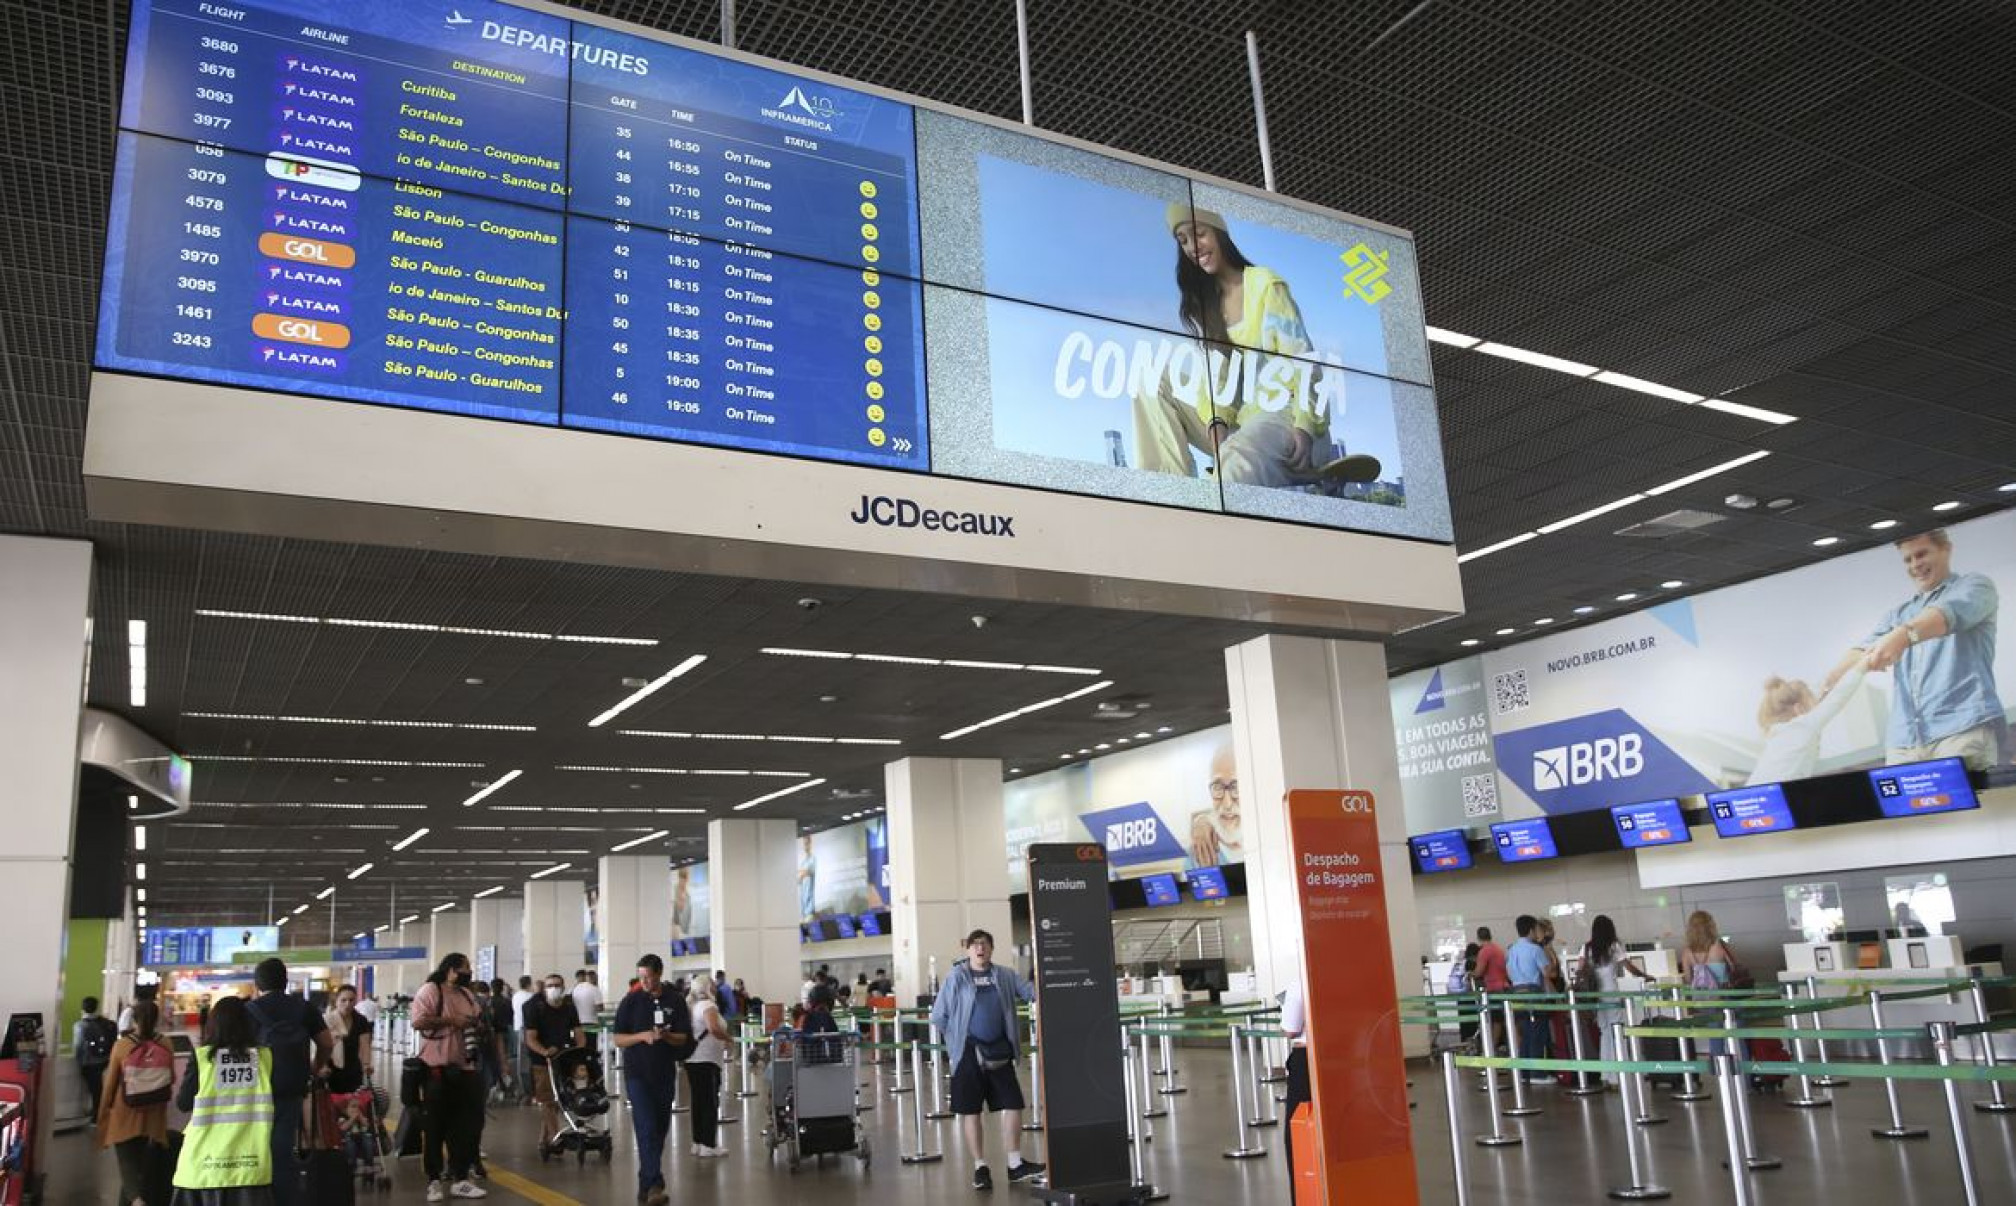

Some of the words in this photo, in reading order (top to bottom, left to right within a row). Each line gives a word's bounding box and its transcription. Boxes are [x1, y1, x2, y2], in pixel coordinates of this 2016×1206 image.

[200, 2, 246, 21] FLIGHT
[301, 26, 349, 46] AIRLINE
[201, 37, 239, 54] 3680
[481, 21, 649, 76] DEPARTURES
[199, 61, 236, 79] 3676
[302, 62, 358, 82] LATAM
[453, 60, 525, 84] DESTINATION
[196, 87, 234, 104] 3093
[299, 87, 355, 106] LATAM
[402, 81, 457, 101] Curitiba
[611, 96, 638, 110] GATE
[193, 113, 231, 130] 3977
[298, 111, 353, 131] LATAM
[401, 105, 464, 127] Fortaleza
[671, 110, 695, 123] TIME
[761, 108, 833, 132] INFRAMERICA
[616, 126, 632, 139] 35
[296, 137, 352, 155] LATAM
[399, 129, 425, 143] São
[429, 134, 468, 152] Paulo
[484, 146, 561, 170] Congonhas
[668, 138, 701, 153] 16:50
[784, 136, 818, 150] STATUS
[616, 149, 632, 162] 44
[725, 150, 742, 163] On
[745, 153, 772, 169] Time
[188, 168, 227, 184] 3079
[415, 156, 432, 169] de
[436, 158, 487, 180] Janeiro
[502, 174, 547, 192] Santos
[668, 160, 701, 176] 16:55
[616, 171, 632, 185] 38
[725, 172, 742, 185] On
[745, 175, 772, 191] Time
[395, 178, 442, 199] Lisbon
[669, 183, 701, 198] 17:10
[186, 195, 224, 211] 4578
[291, 190, 348, 209] LATAM
[616, 195, 631, 208] 39
[725, 194, 742, 207] On
[745, 197, 772, 213] Time
[668, 205, 701, 221] 17:15
[184, 222, 221, 238] 1485
[289, 216, 346, 235] LATAM
[393, 205, 421, 220] São
[424, 210, 465, 228] Paulo
[480, 221, 558, 245] Congonhas
[725, 216, 742, 229] On
[745, 219, 773, 236] Time
[392, 230, 444, 249] Maceió
[180, 249, 220, 265] 3970
[285, 240, 328, 261] GOL
[614, 245, 630, 257] 42
[725, 240, 742, 253] On
[745, 242, 773, 260] Time
[668, 254, 700, 270] 18:10
[285, 268, 342, 287] LATAM
[391, 256, 418, 271] São
[422, 260, 462, 278] Paulo
[475, 269, 546, 292] Guarulhos
[613, 269, 628, 281] 51
[725, 265, 742, 277] On
[745, 267, 773, 284] Time
[177, 276, 217, 292] 3095
[667, 278, 700, 293] 18:15
[282, 297, 340, 314] LATAM
[407, 285, 425, 298] de
[429, 287, 481, 307] Janeiro
[496, 299, 543, 318] Santos
[615, 293, 629, 304] 10
[725, 288, 742, 300] On
[745, 290, 773, 306] Time
[176, 305, 213, 319] 1461
[667, 302, 700, 317] 18:30
[388, 308, 415, 323] São
[418, 313, 460, 330] Paulo
[476, 321, 555, 344] Congonhas
[613, 318, 629, 329] 50
[725, 312, 743, 324] On
[745, 314, 773, 330] Time
[279, 321, 323, 341] GOL
[667, 326, 700, 340] 18:35
[172, 332, 212, 348] 3243
[725, 336, 743, 348] On
[745, 338, 774, 353] Time
[385, 334, 413, 349] São
[417, 339, 459, 356] Paulo
[475, 347, 554, 370] Congonhas
[612, 343, 628, 355] 45
[667, 350, 700, 365] 18:35
[279, 350, 337, 367] LATAM
[616, 367, 625, 378] 5
[725, 360, 743, 372] On
[745, 362, 774, 377] Time
[1054, 330, 1348, 418] CONQUISTA
[384, 361, 412, 376] São
[416, 366, 458, 382] Paulo
[470, 373, 543, 394] Guarulhos
[667, 374, 700, 389] 19:00
[612, 392, 628, 404] 46
[726, 384, 744, 395] On
[746, 386, 775, 401] Time
[667, 399, 700, 414] 19:05
[726, 408, 744, 420] On
[746, 410, 775, 425] Time
[851, 496, 1016, 537] JCDecaux
[1547, 637, 1656, 674] NOVO.BRB.COM.BR
[1406, 729, 1424, 742] EM
[1426, 717, 1467, 738] TODAS
[1469, 713, 1486, 729] AS
[1411, 743, 1435, 758] BOA
[1437, 730, 1488, 753] VIAGEM
[1421, 758, 1445, 775] SUA
[1447, 750, 1491, 770] CONTA.
[1571, 732, 1645, 785] BRB
[1342, 796, 1373, 812] GOL
[1124, 818, 1157, 849] BRB
[1077, 845, 1104, 861] GOL
[1304, 852, 1359, 868] Despacho
[1039, 877, 1087, 890] Premium
[1307, 872, 1321, 885] de
[221, 1067, 253, 1083] 1973
